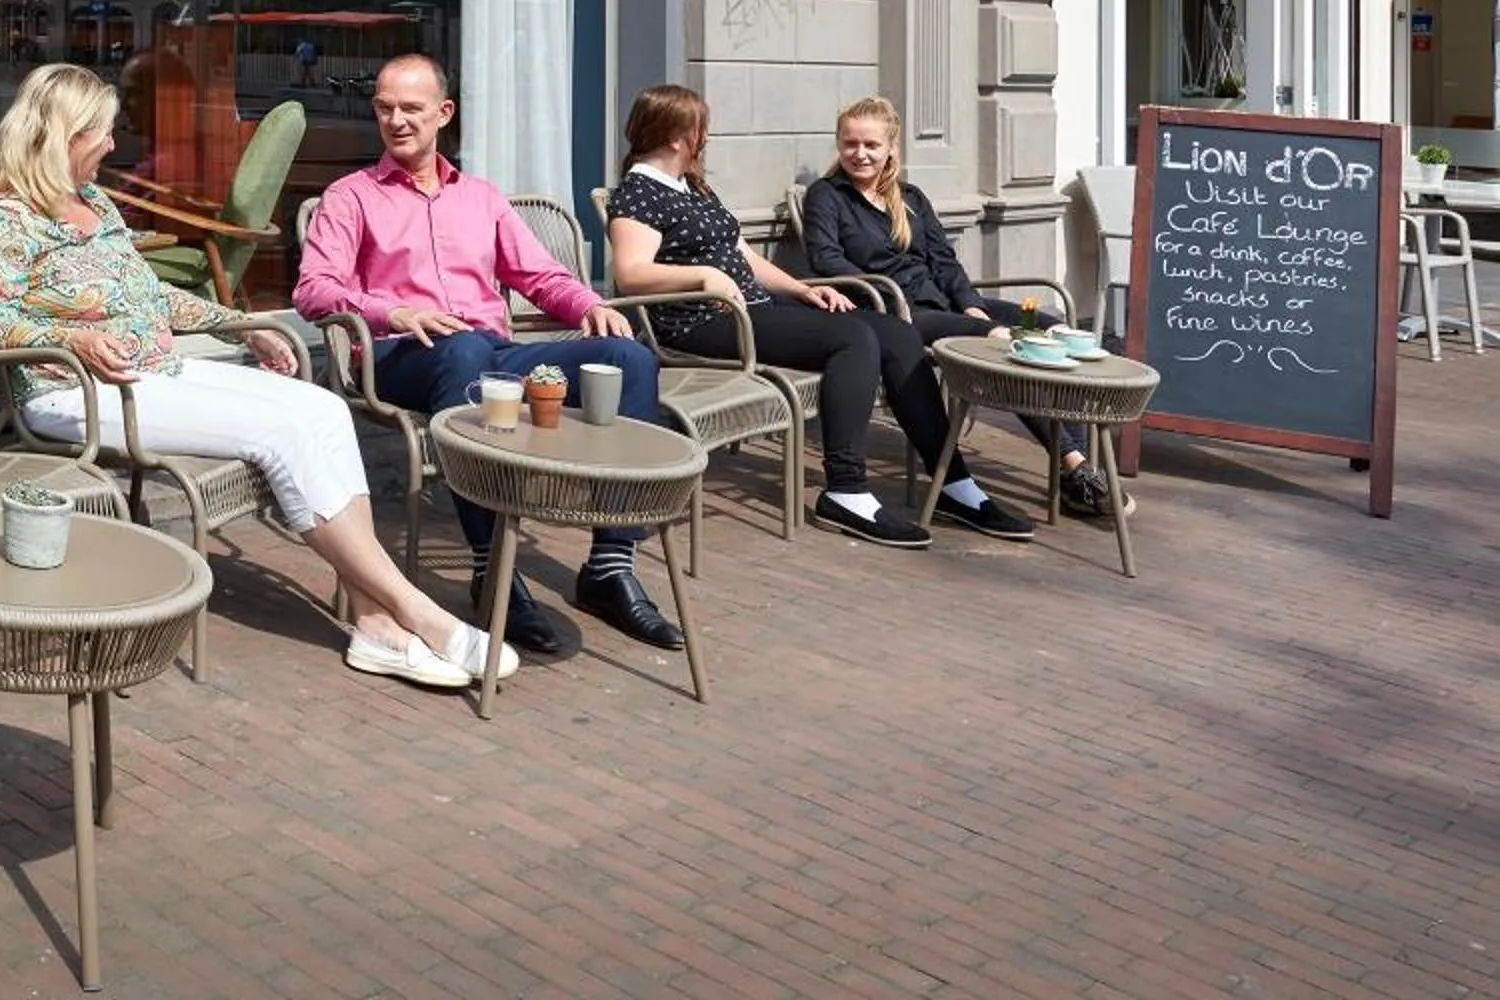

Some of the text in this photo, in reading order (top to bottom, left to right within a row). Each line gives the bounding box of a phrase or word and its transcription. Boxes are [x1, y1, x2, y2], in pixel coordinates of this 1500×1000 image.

[1185, 180, 1332, 211] Visit our
[1256, 212, 1368, 255] Lounge
[1187, 245, 1203, 256] a
[1209, 241, 1269, 264] drink,
[1277, 247, 1353, 271] coffee,
[1181, 285, 1315, 309] snacks or
